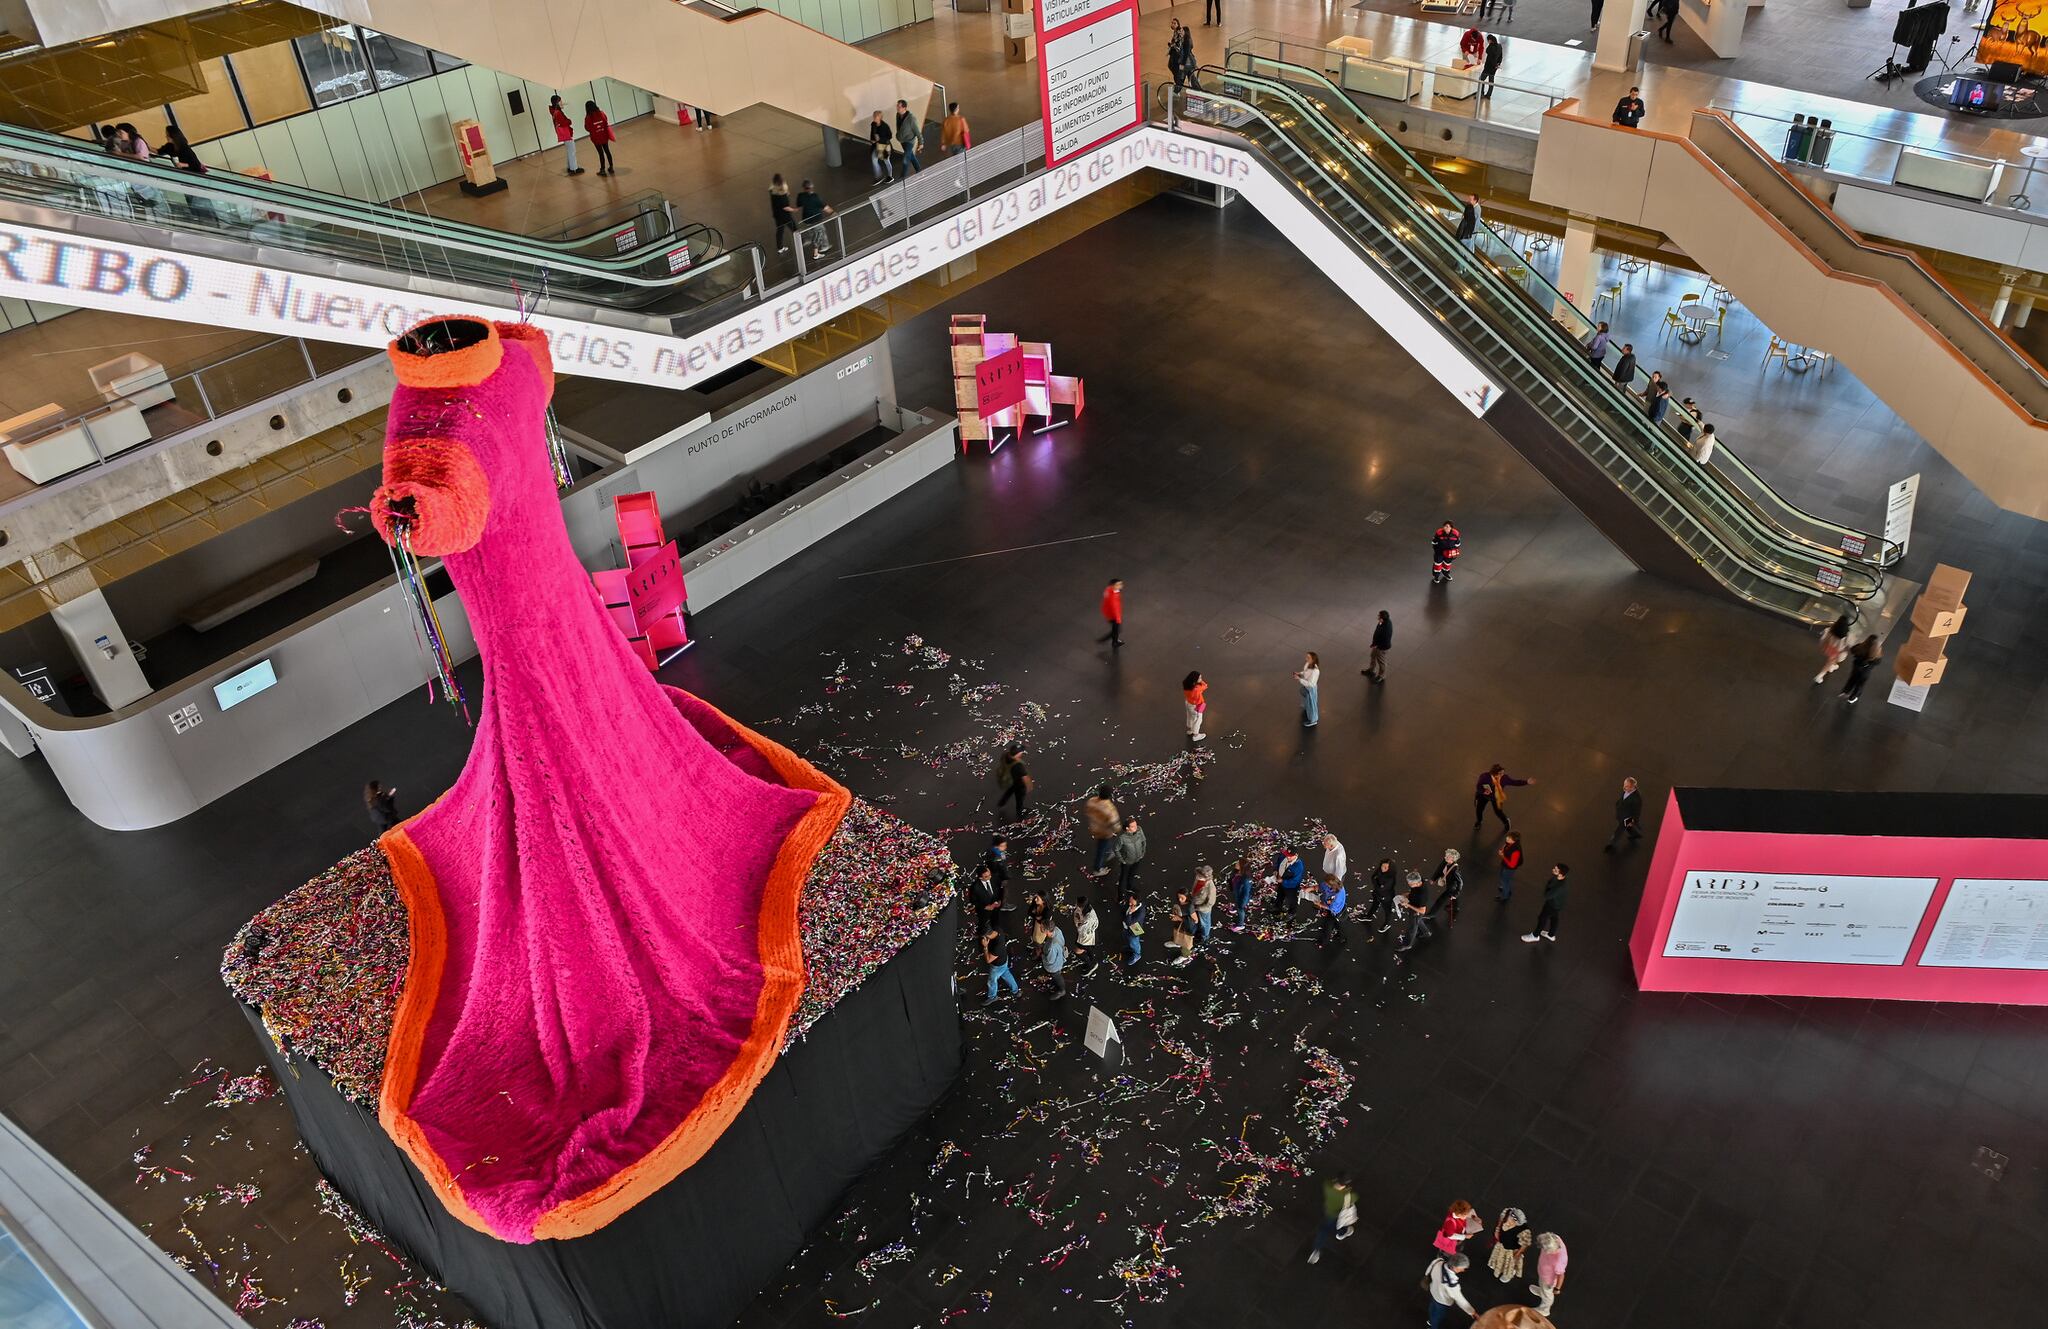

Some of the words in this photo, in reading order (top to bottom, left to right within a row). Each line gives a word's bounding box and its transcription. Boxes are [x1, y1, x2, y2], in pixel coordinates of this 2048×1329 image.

[1046, 1, 1090, 25] ARTICULARTE
[1089, 33, 1094, 44] 1
[1050, 69, 1068, 84] SITIO
[1052, 82, 1083, 104] REGISTRO
[1088, 70, 1110, 88] PUNTO
[1053, 106, 1062, 117] DE
[1063, 84, 1107, 112] INFORMACIÓN
[1054, 111, 1091, 135] ALIMENTOS
[1091, 109, 1096, 119] Y
[1097, 96, 1123, 116] BEBIDAS
[1056, 137, 1079, 155] SALIDA
[249, 269, 435, 335] Nuevo
[774, 245, 921, 333] realidades
[944, 206, 983, 251] del
[991, 191, 1020, 231] 23
[1028, 178, 1046, 213] al
[1054, 162, 1082, 200] 26
[1088, 151, 1114, 184] de
[687, 434, 720, 456] PUNTO
[721, 426, 734, 439] DE
[736, 394, 798, 432] INFORMACIÓN
[1942, 617, 1952, 628] 4
[1923, 667, 1933, 679] 2
